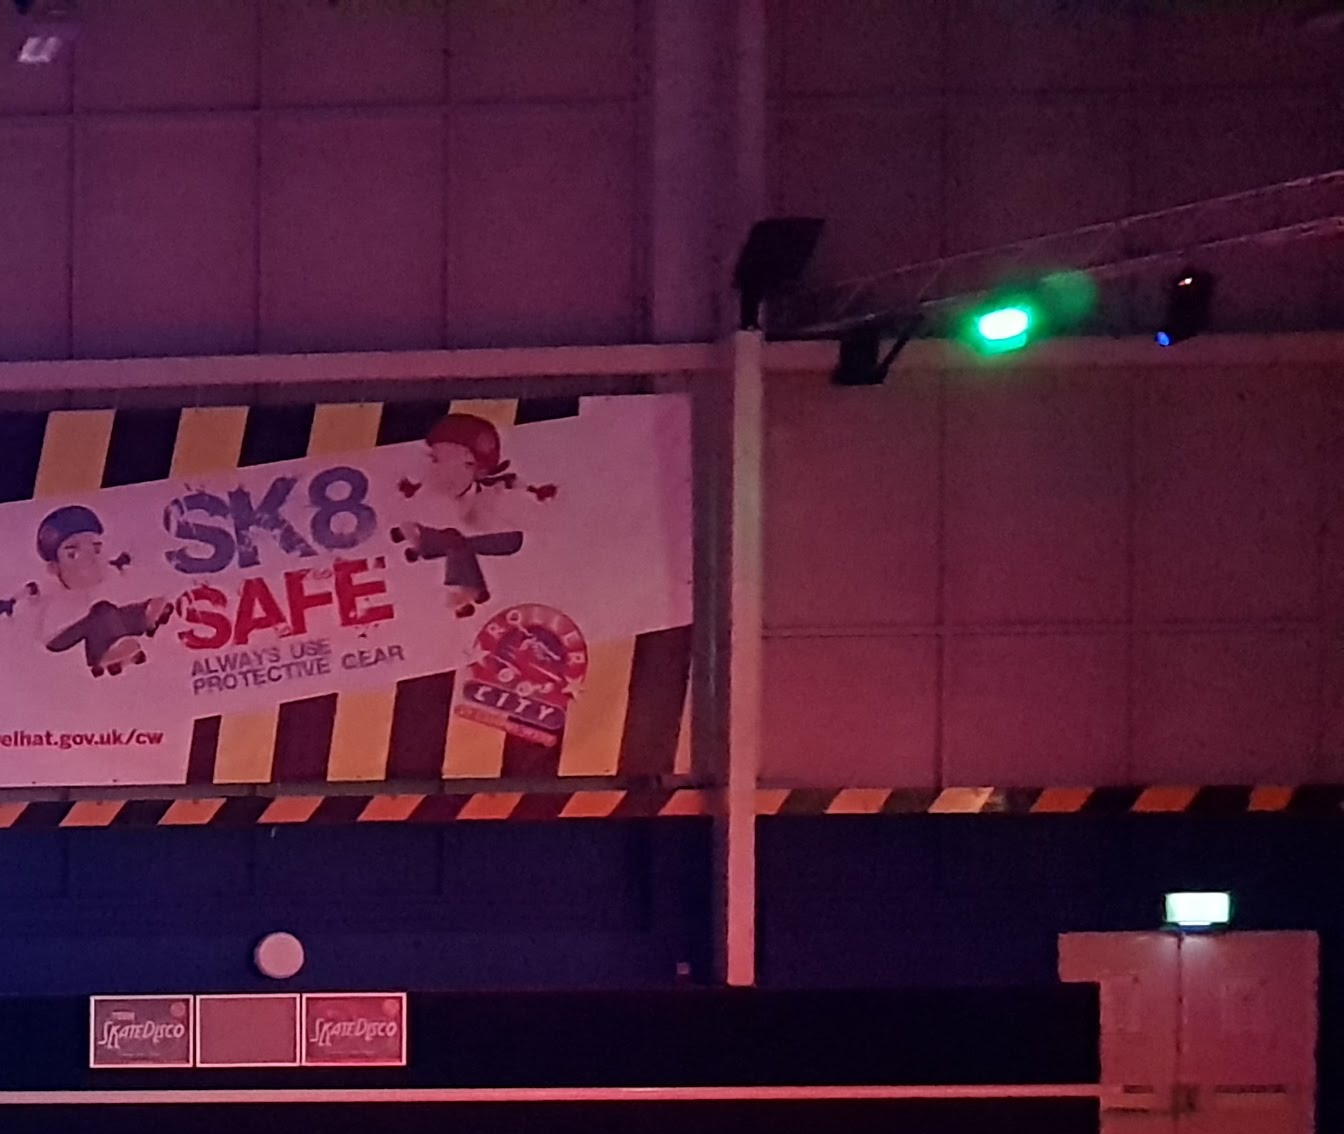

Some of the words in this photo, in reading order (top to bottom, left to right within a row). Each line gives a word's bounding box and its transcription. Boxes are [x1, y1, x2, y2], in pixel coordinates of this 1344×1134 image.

[163, 466, 378, 574] SK8
[176, 556, 394, 650] SAFE
[192, 646, 280, 676] ALWAYS
[290, 639, 332, 660] USE
[193, 658, 332, 695] PROTECTIVE
[342, 645, 404, 670] GEAR
[474, 685, 555, 721] CITY
